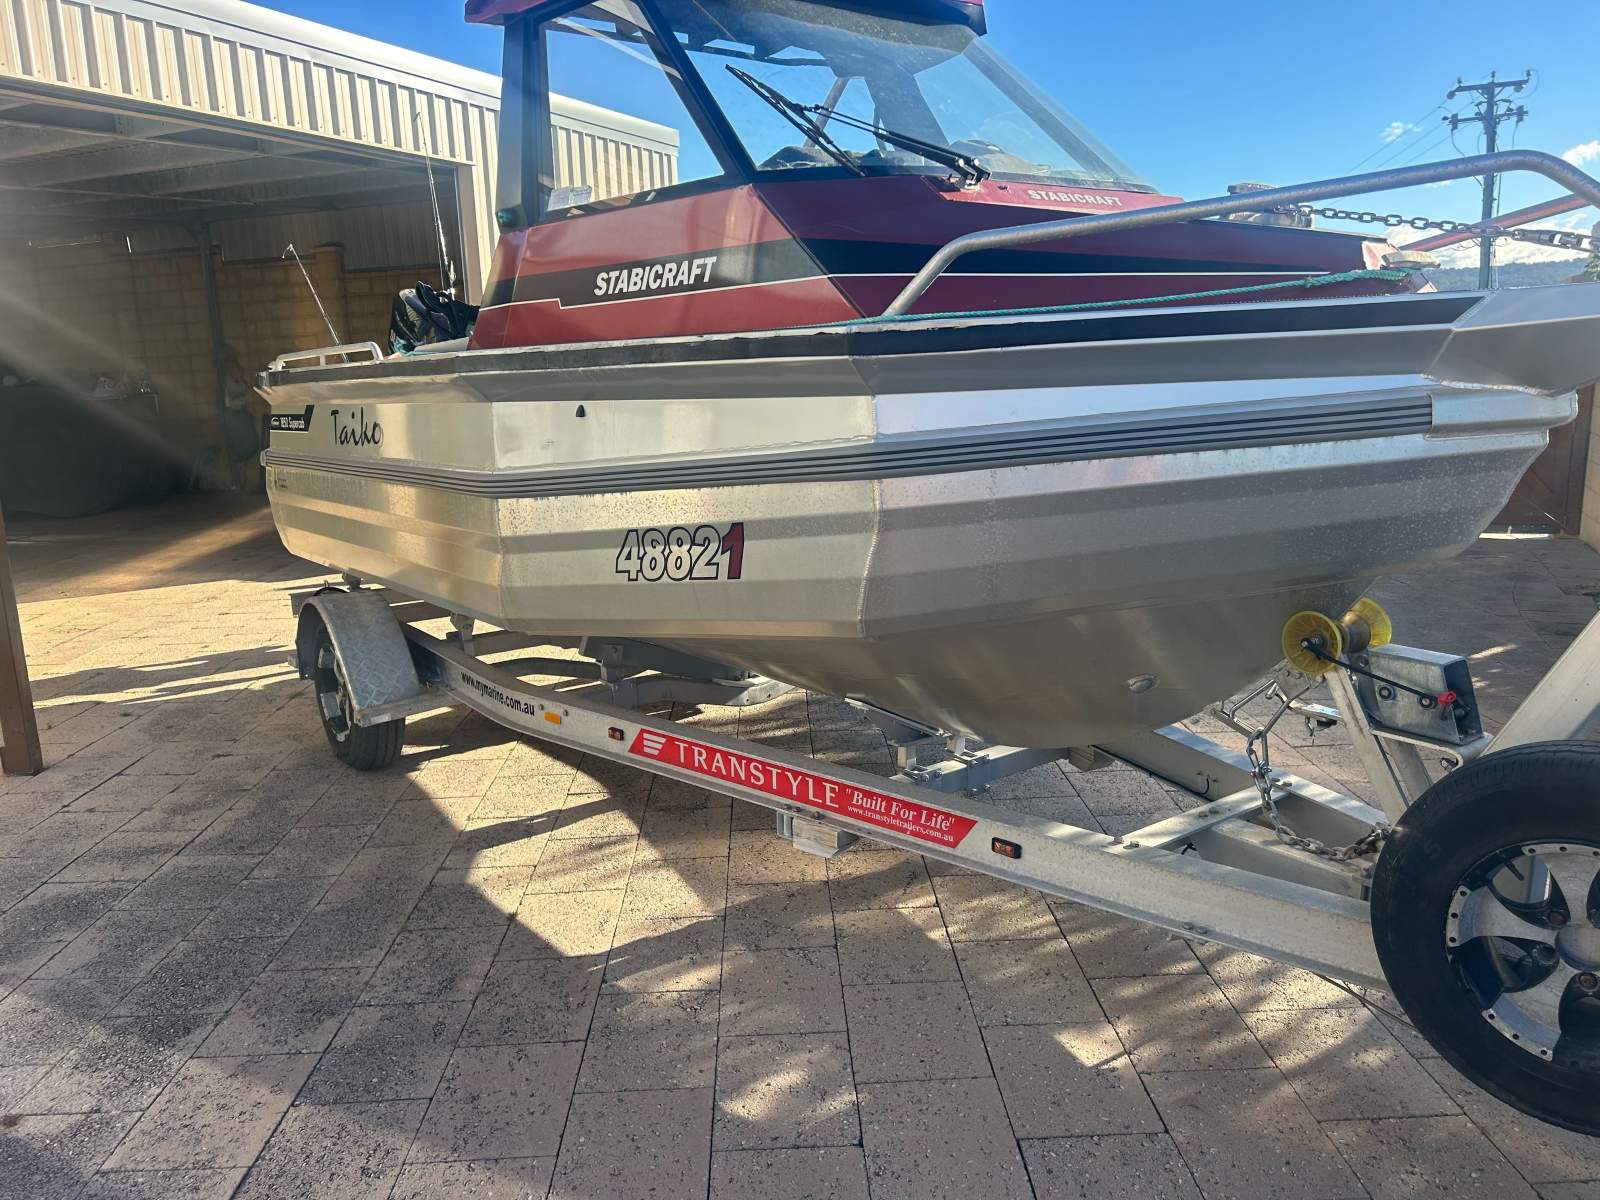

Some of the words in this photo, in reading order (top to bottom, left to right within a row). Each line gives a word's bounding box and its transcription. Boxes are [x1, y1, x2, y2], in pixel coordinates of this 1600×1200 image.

[1027, 189, 1123, 207] STABICRAFT
[594, 256, 718, 296] STABICRAFT
[330, 407, 384, 448] Taiko
[615, 522, 745, 582] 48821
[460, 671, 535, 717] www.mymarine.com.au
[674, 740, 840, 808] TRANSTYLE
[889, 801, 917, 820] For
